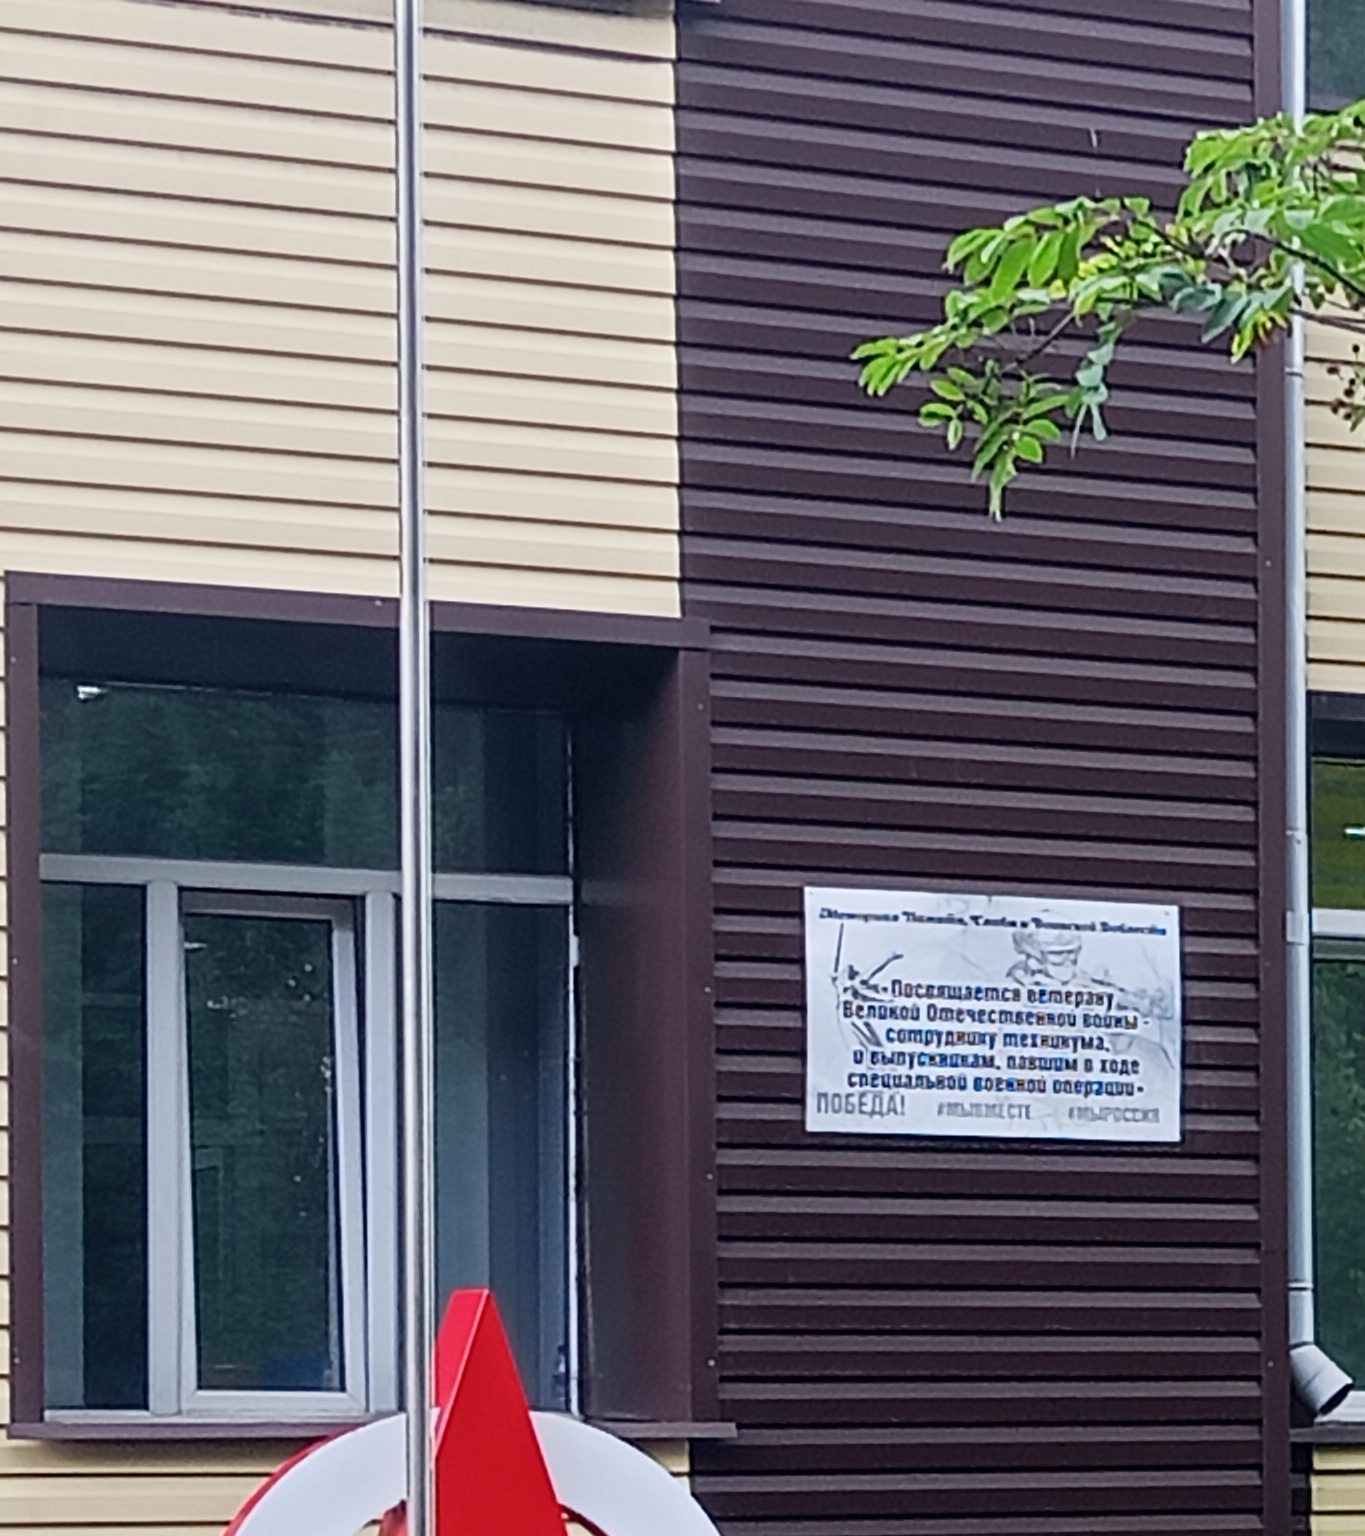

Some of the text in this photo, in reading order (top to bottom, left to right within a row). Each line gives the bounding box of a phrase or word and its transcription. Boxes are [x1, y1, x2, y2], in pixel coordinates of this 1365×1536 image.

[843, 1000, 921, 1021] Великой
[927, 1002, 1077, 1027] Отечественной
[885, 1027, 998, 1050] сотруднику
[1006, 1054, 1079, 1073] павшим
[1083, 1058, 1094, 1073] в
[1100, 1059, 1141, 1077] ходе
[847, 1072, 968, 1092] специальной
[973, 1074, 1047, 1094] военной
[816, 1091, 906, 1118] ПОБЕДА!
